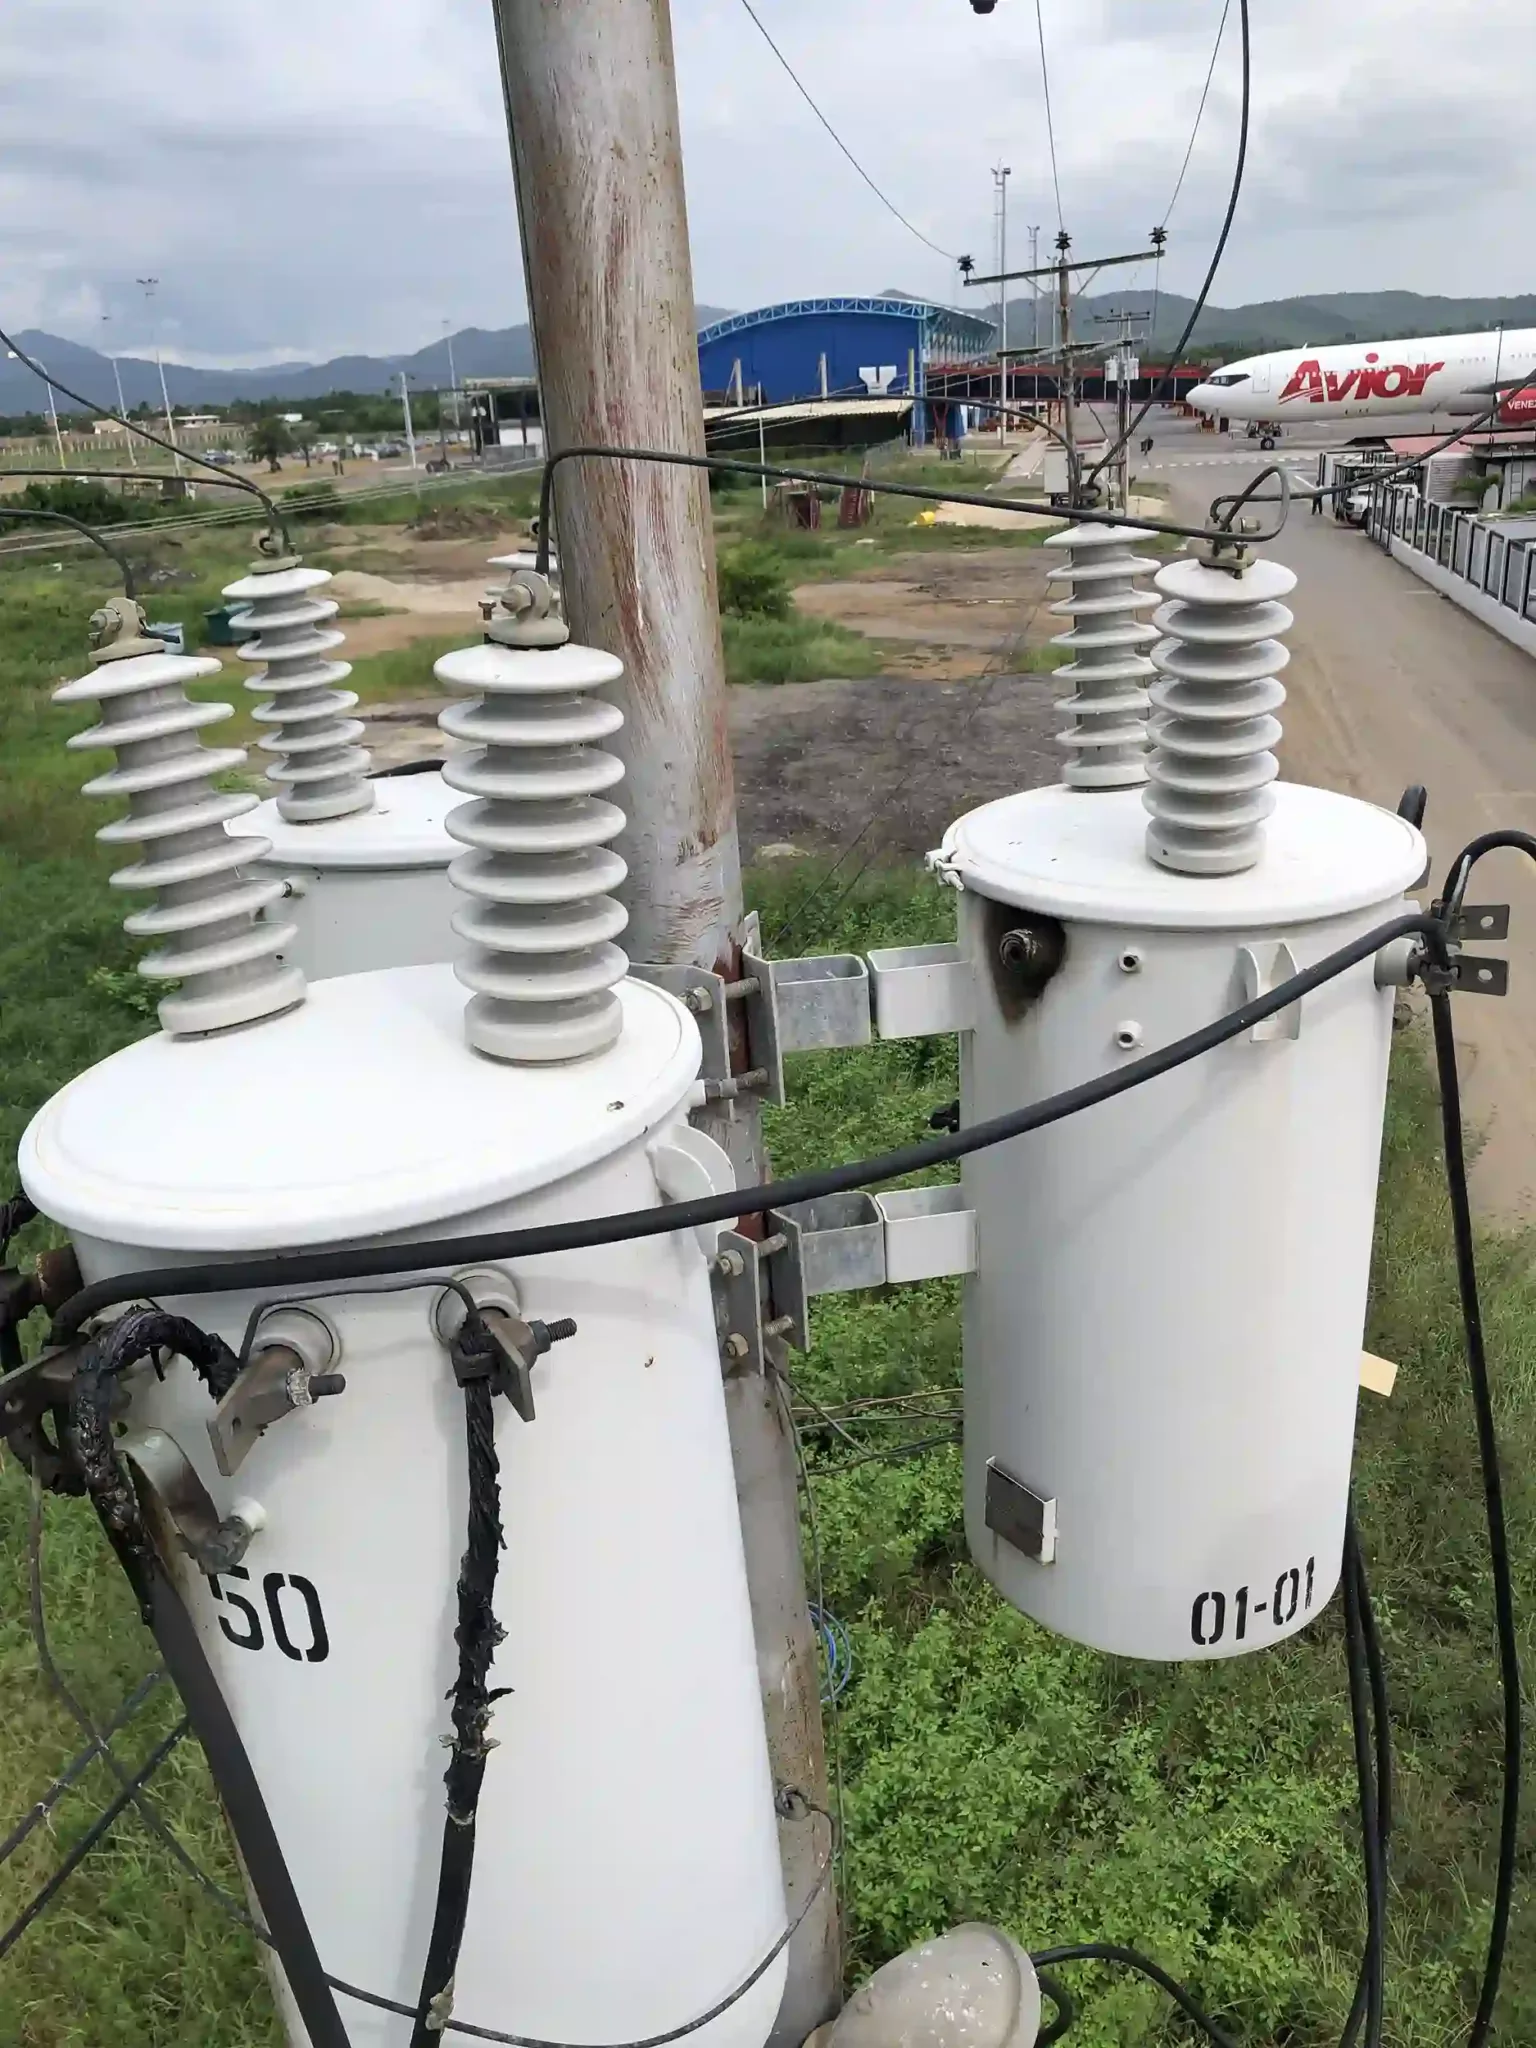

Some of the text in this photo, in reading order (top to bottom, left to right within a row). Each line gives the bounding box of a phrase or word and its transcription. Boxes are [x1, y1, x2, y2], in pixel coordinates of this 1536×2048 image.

[1278, 353, 1445, 405] Avior
[207, 1564, 329, 1662] 50
[1191, 1556, 1315, 1645] 01-01
